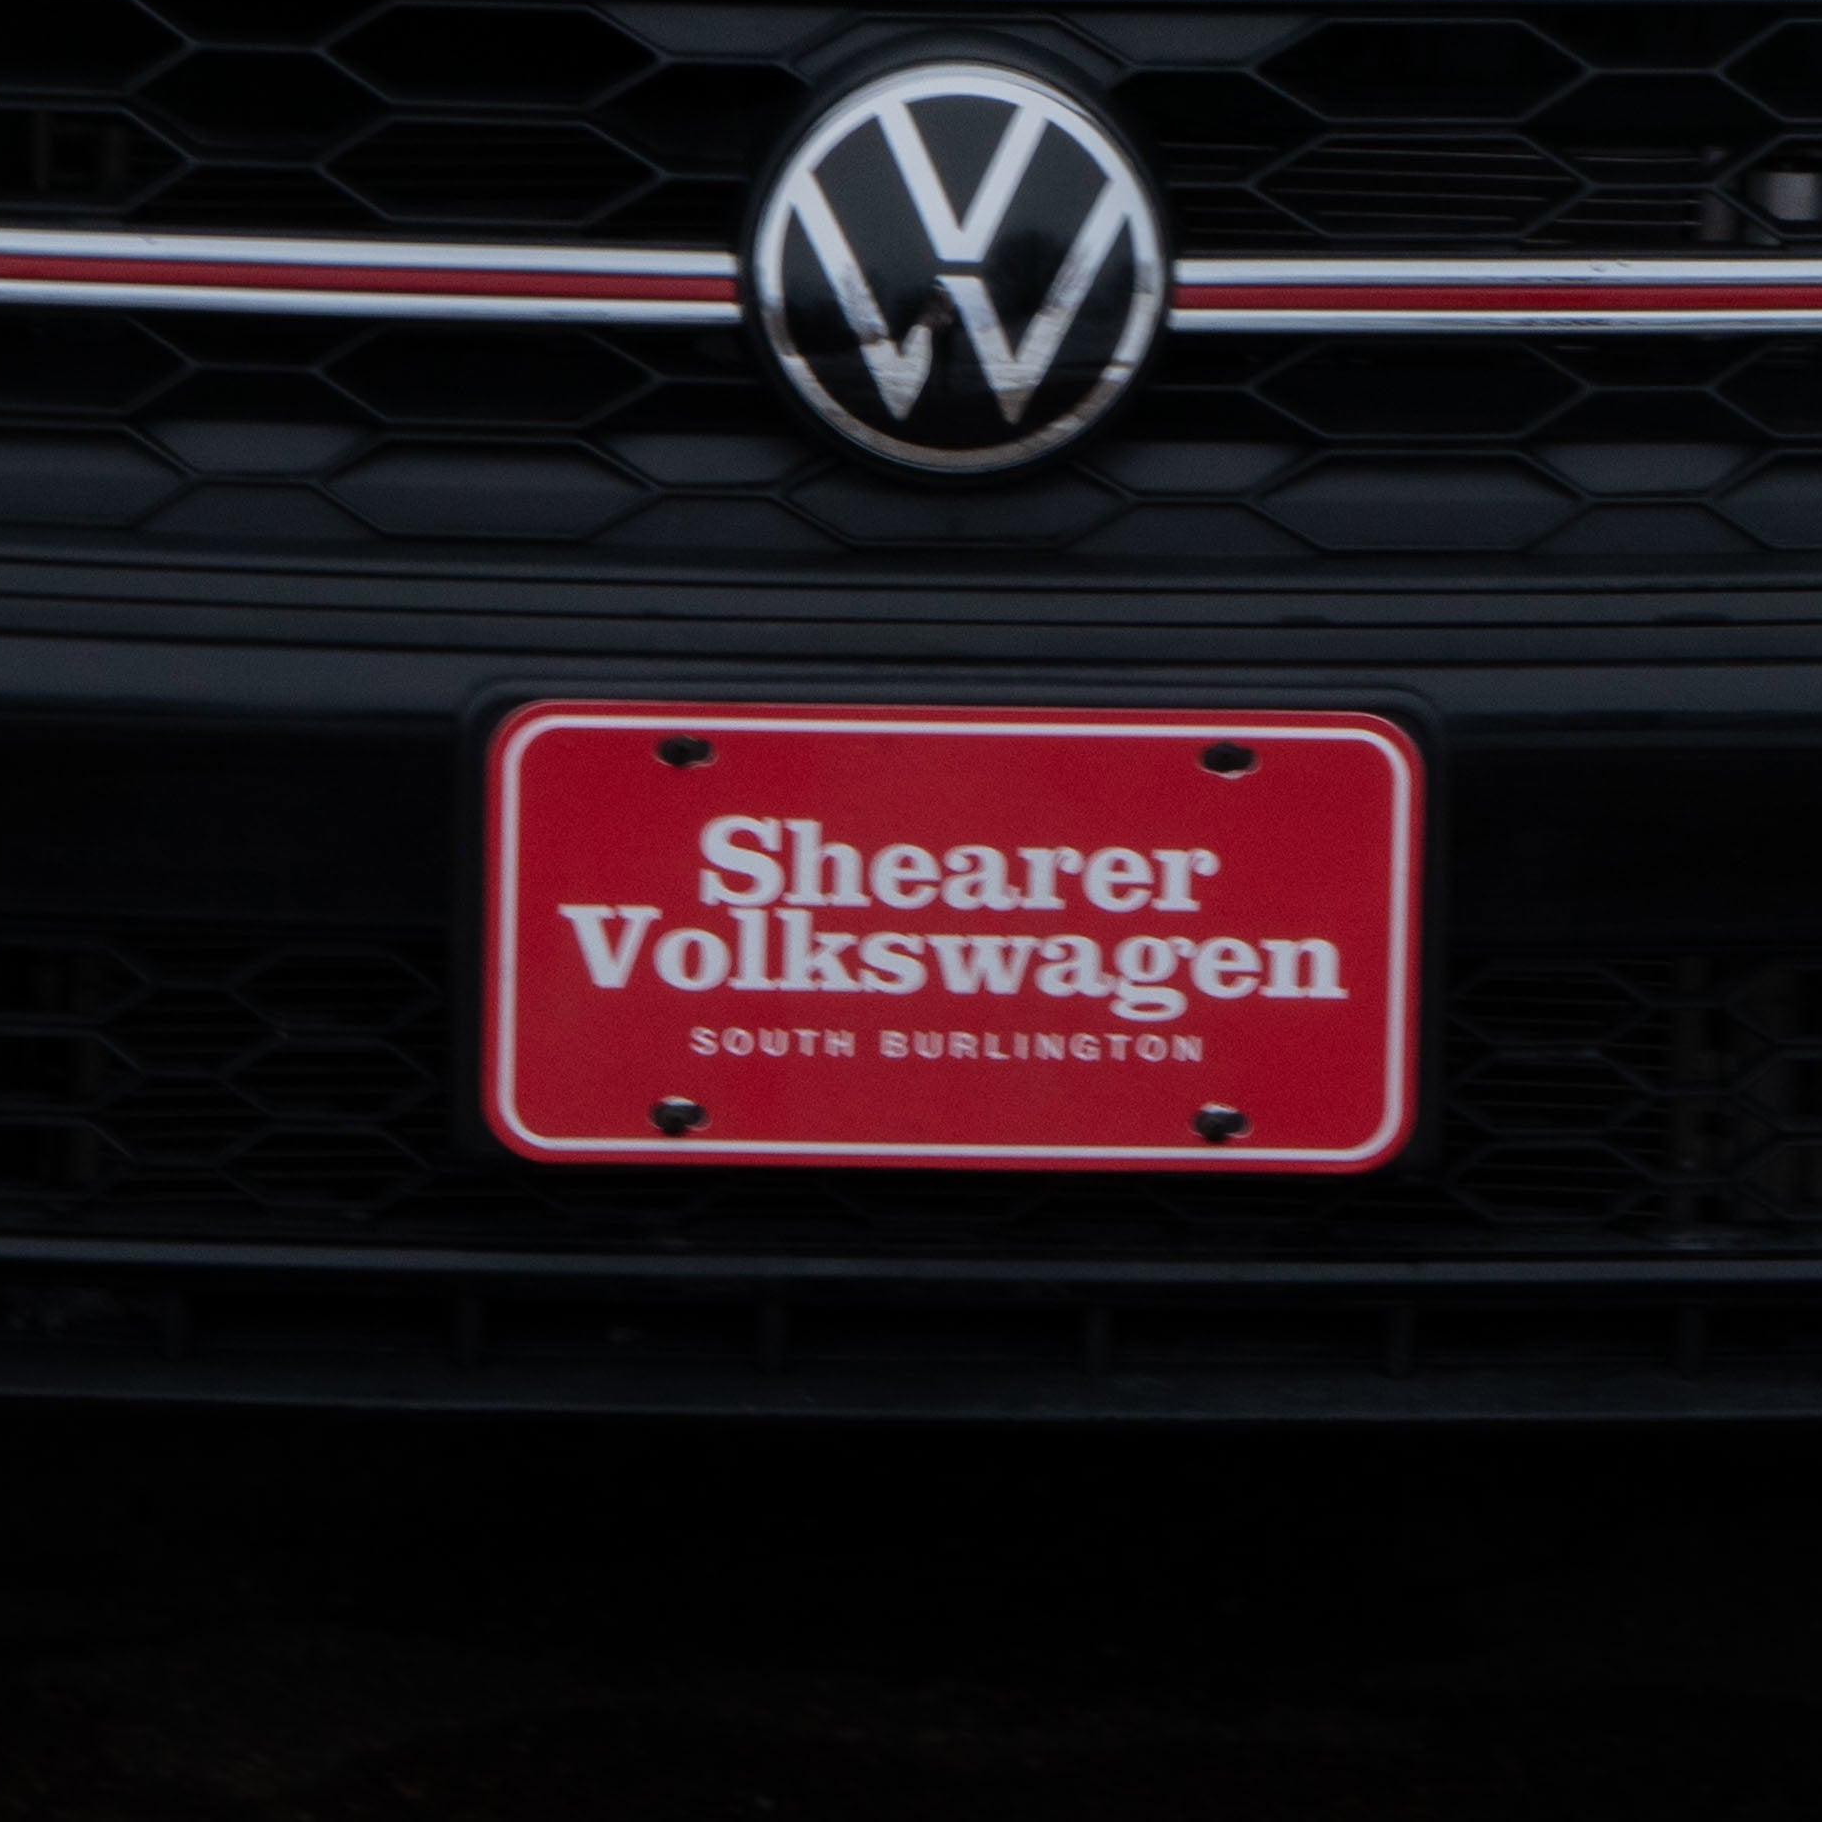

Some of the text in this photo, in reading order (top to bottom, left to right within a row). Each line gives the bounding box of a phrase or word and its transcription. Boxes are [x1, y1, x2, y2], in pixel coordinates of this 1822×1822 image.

[699, 815, 1220, 911] Shearer
[558, 904, 1349, 1022] Volkswagen
[690, 1026, 1205, 1064] SOUTH BURLINGTON
